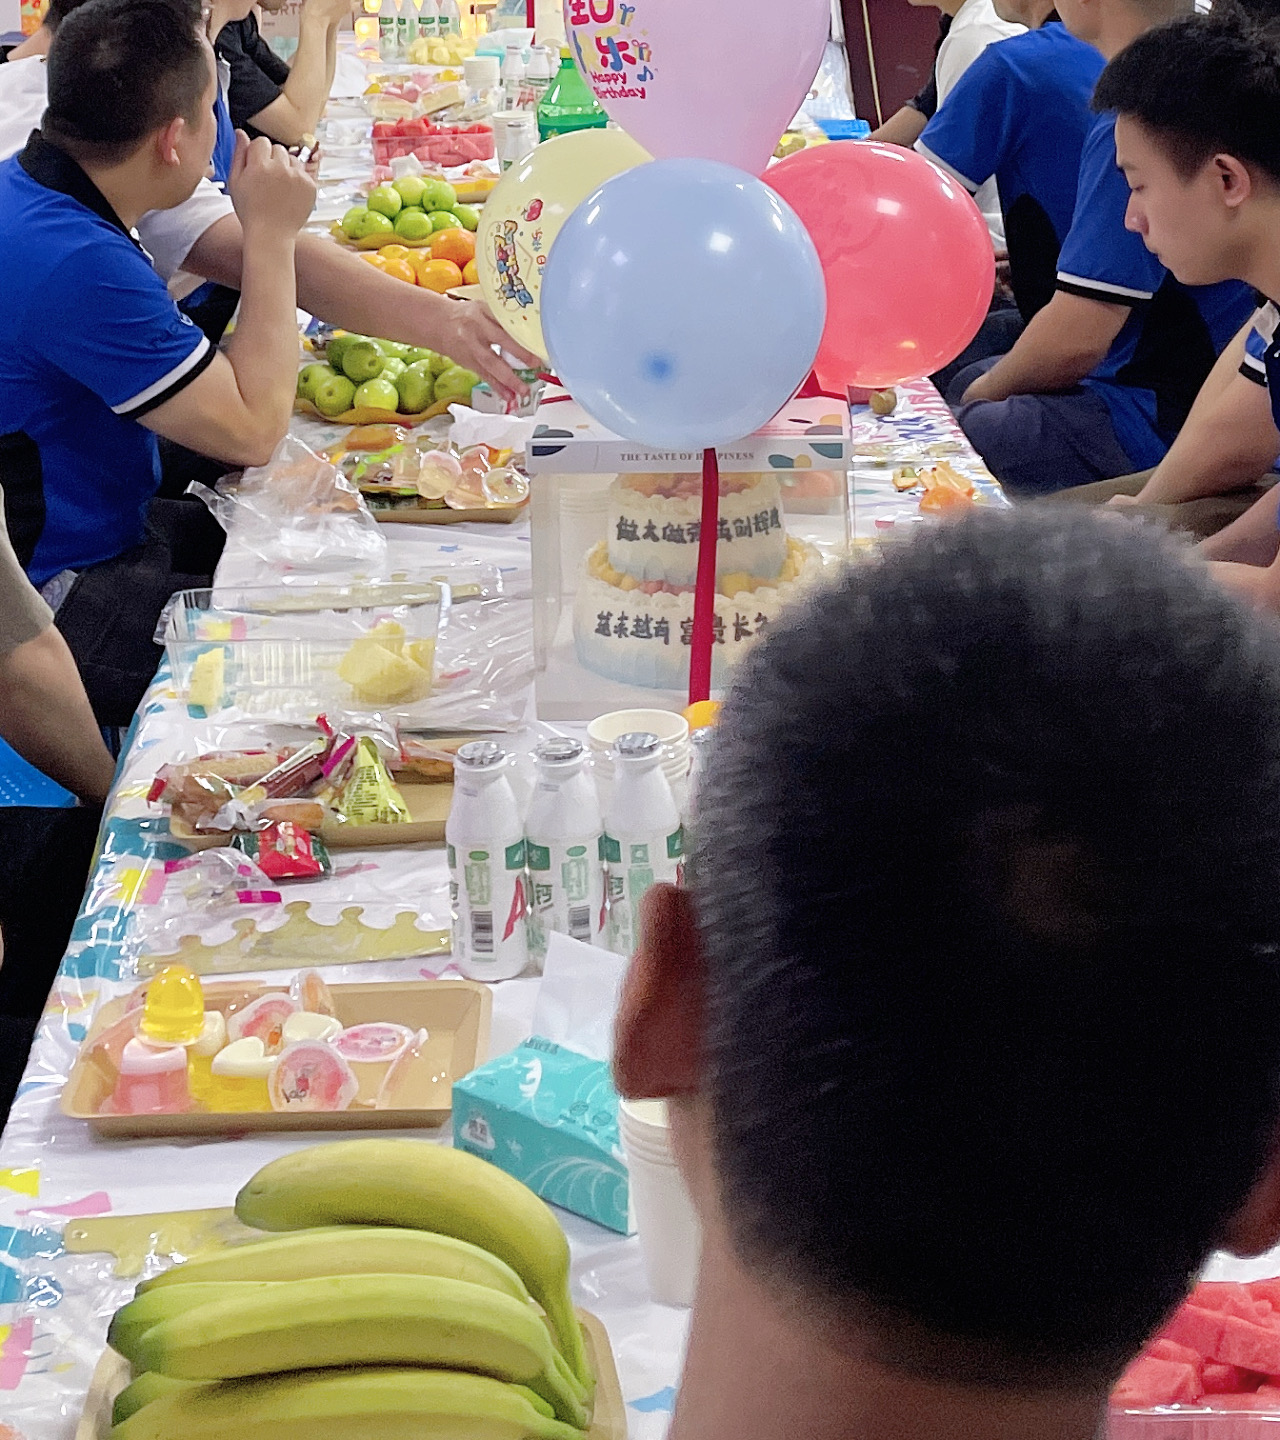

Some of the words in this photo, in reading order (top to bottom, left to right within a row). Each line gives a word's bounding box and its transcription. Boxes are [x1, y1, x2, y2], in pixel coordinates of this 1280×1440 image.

[590, 71, 628, 85] Happy
[593, 85, 647, 100] Birthday
[620, 453, 641, 461] THE
[643, 452, 677, 461] TASTE
[679, 452, 693, 461] OF
